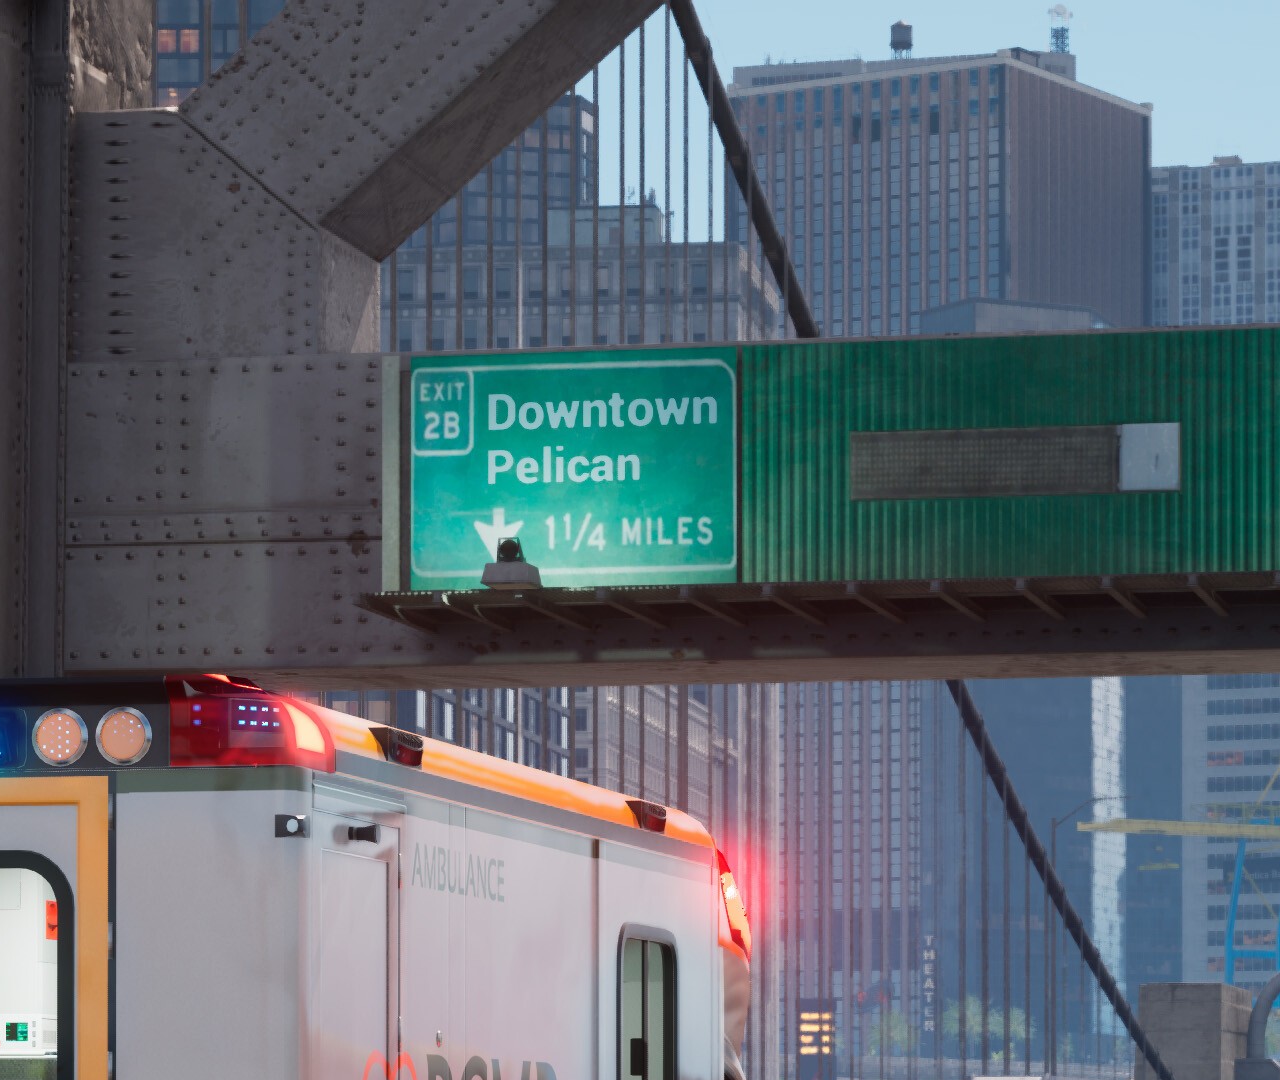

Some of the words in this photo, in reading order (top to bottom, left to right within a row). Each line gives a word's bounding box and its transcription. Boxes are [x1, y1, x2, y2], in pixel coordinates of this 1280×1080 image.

[420, 382, 465, 402] EXIT
[488, 392, 718, 431] Downtown
[423, 411, 460, 440] 2B
[487, 445, 641, 485] Pelican
[622, 516, 713, 546] MILES
[412, 842, 506, 902] AMBULANCE
[923, 935, 936, 1032] THEATER
